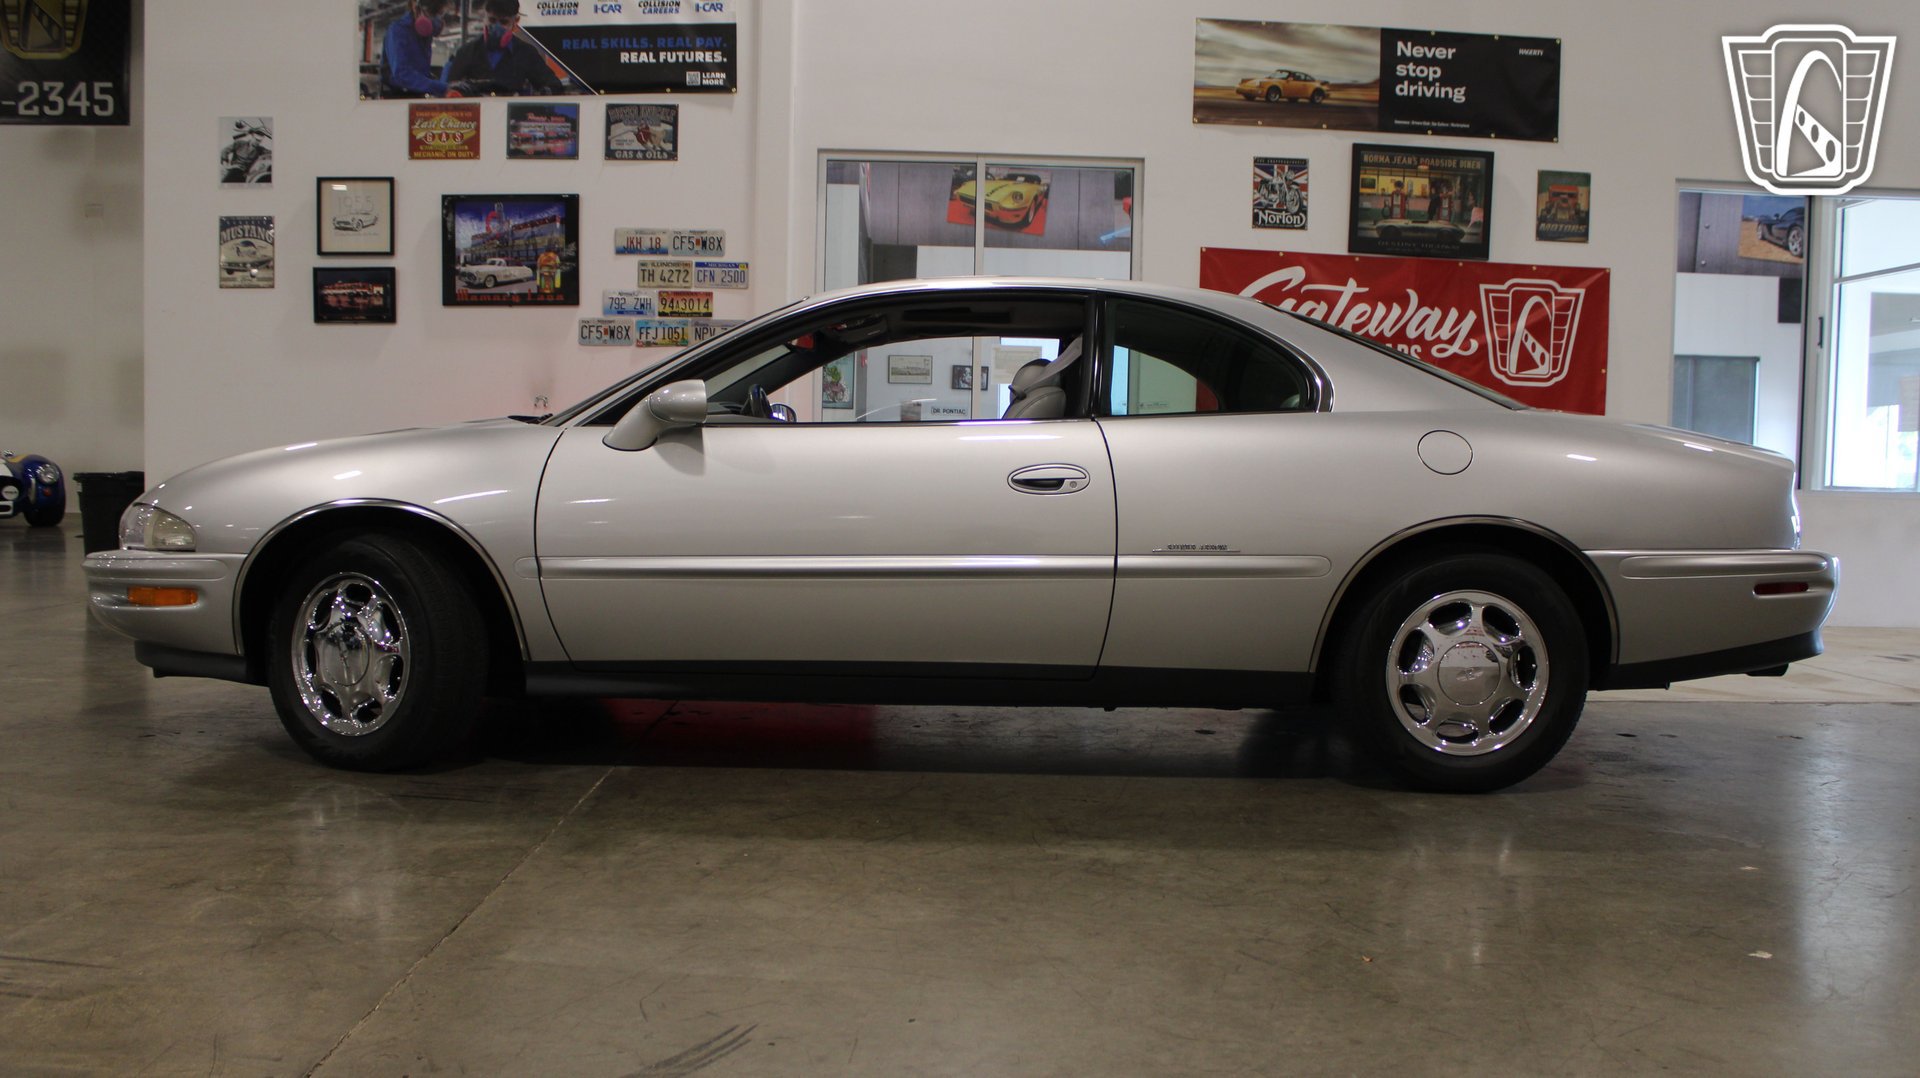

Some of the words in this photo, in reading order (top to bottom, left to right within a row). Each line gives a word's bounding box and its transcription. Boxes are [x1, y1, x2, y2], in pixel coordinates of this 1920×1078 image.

[537, 1, 579, 10] COLLISION
[594, 3, 622, 14] I-CAR
[638, 0, 681, 9] COLLISION
[695, 2, 724, 12] I-CAR
[541, 8, 578, 16] CAREERS
[562, 39, 598, 49] REAL
[601, 38, 653, 49] SKILLS.
[657, 37, 692, 48] REAL
[695, 36, 727, 47] PAY.
[1396, 41, 1456, 60] Never
[620, 52, 657, 63] REAL
[659, 51, 728, 63] FUTURES.
[1395, 62, 1442, 81] stop
[1395, 80, 1467, 103] driving
[439, 118, 477, 129] Chance
[615, 150, 634, 159] GAS
[636, 150, 643, 158] &
[645, 150, 668, 159] OILS
[1254, 209, 1306, 228] Norton
[220, 224, 274, 244] MUSTANG
[640, 269, 655, 282] TH
[659, 269, 690, 283] 4272
